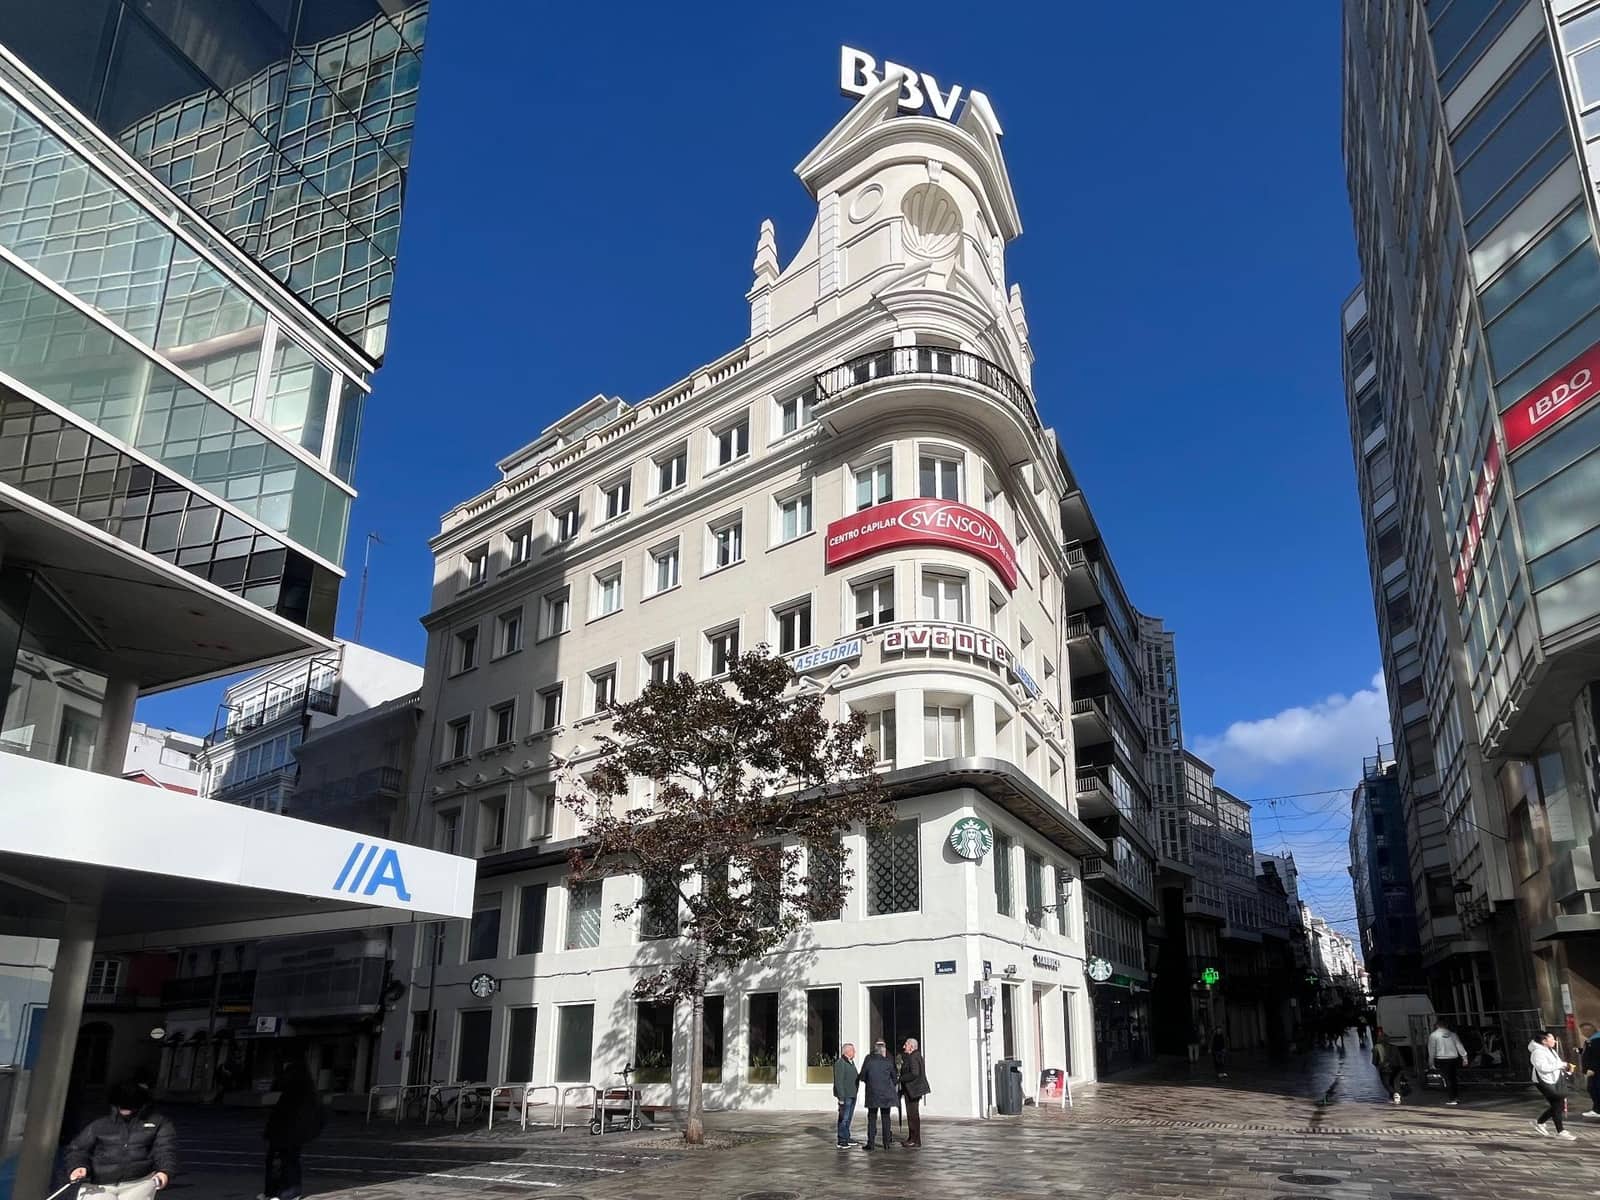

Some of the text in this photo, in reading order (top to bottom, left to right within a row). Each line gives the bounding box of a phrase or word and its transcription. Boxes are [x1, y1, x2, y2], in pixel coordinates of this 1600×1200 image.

[829, 511, 993, 547] CENTRO CAPILAR SVENSON
[795, 639, 859, 669] ASESORIA
[886, 630, 1005, 660] avante
